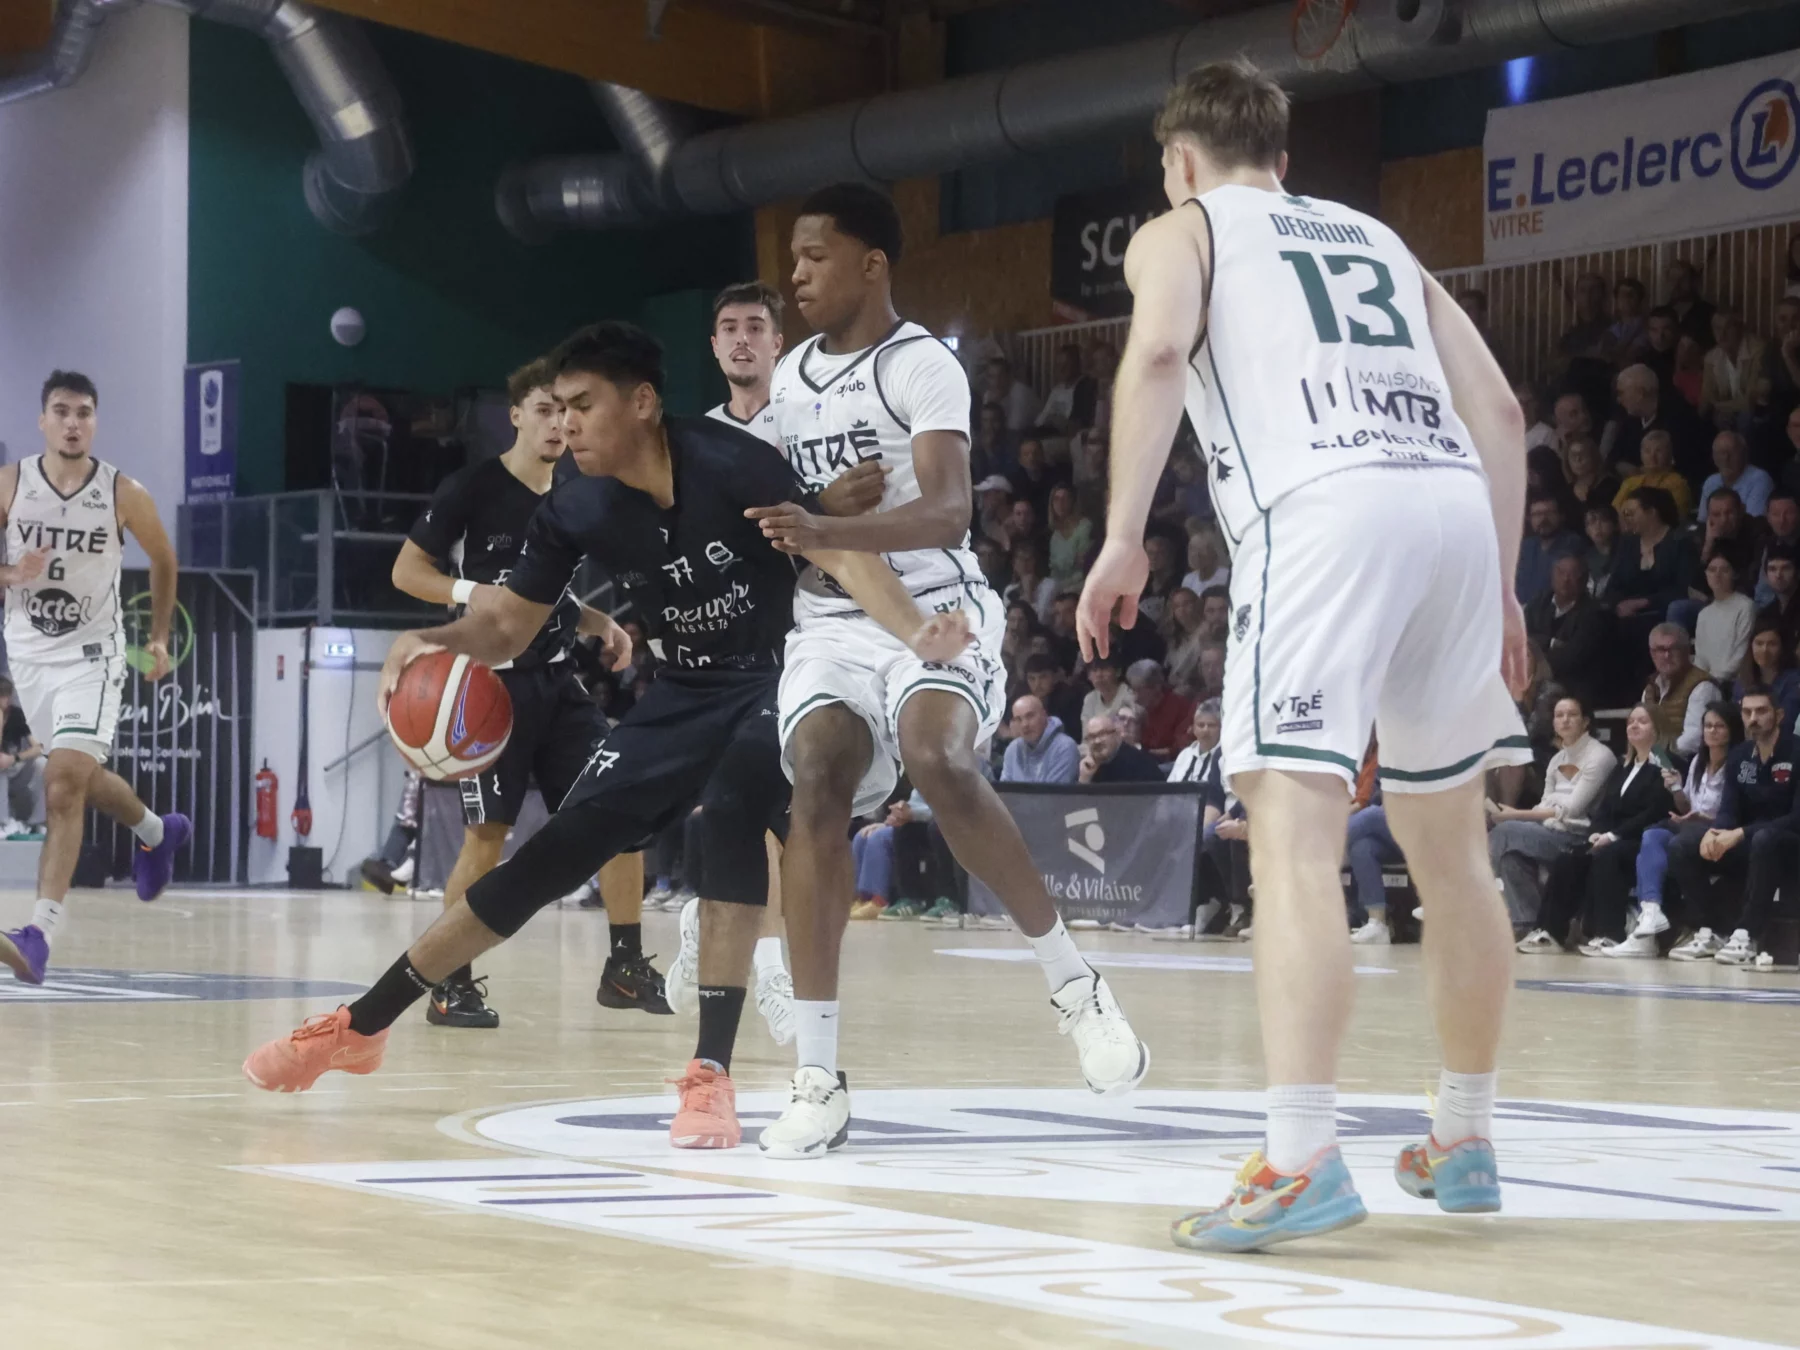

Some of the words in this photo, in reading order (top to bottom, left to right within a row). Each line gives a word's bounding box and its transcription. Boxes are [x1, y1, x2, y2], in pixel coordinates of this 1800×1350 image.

[1488, 132, 1723, 211] E.Leclerc
[1269, 213, 1375, 248] DEBRUHL
[1279, 250, 1415, 350] 13
[1358, 370, 1441, 394] MAISONS
[1361, 388, 1441, 429] MTB
[48, 558, 65, 581] 6
[661, 556, 694, 587] 77
[21, 588, 92, 627] lactel
[947, 664, 976, 684] MSD
[1272, 689, 1323, 719] VTRÉ
[1066, 873, 1081, 900] &
[1084, 876, 1142, 902] Vilaine
